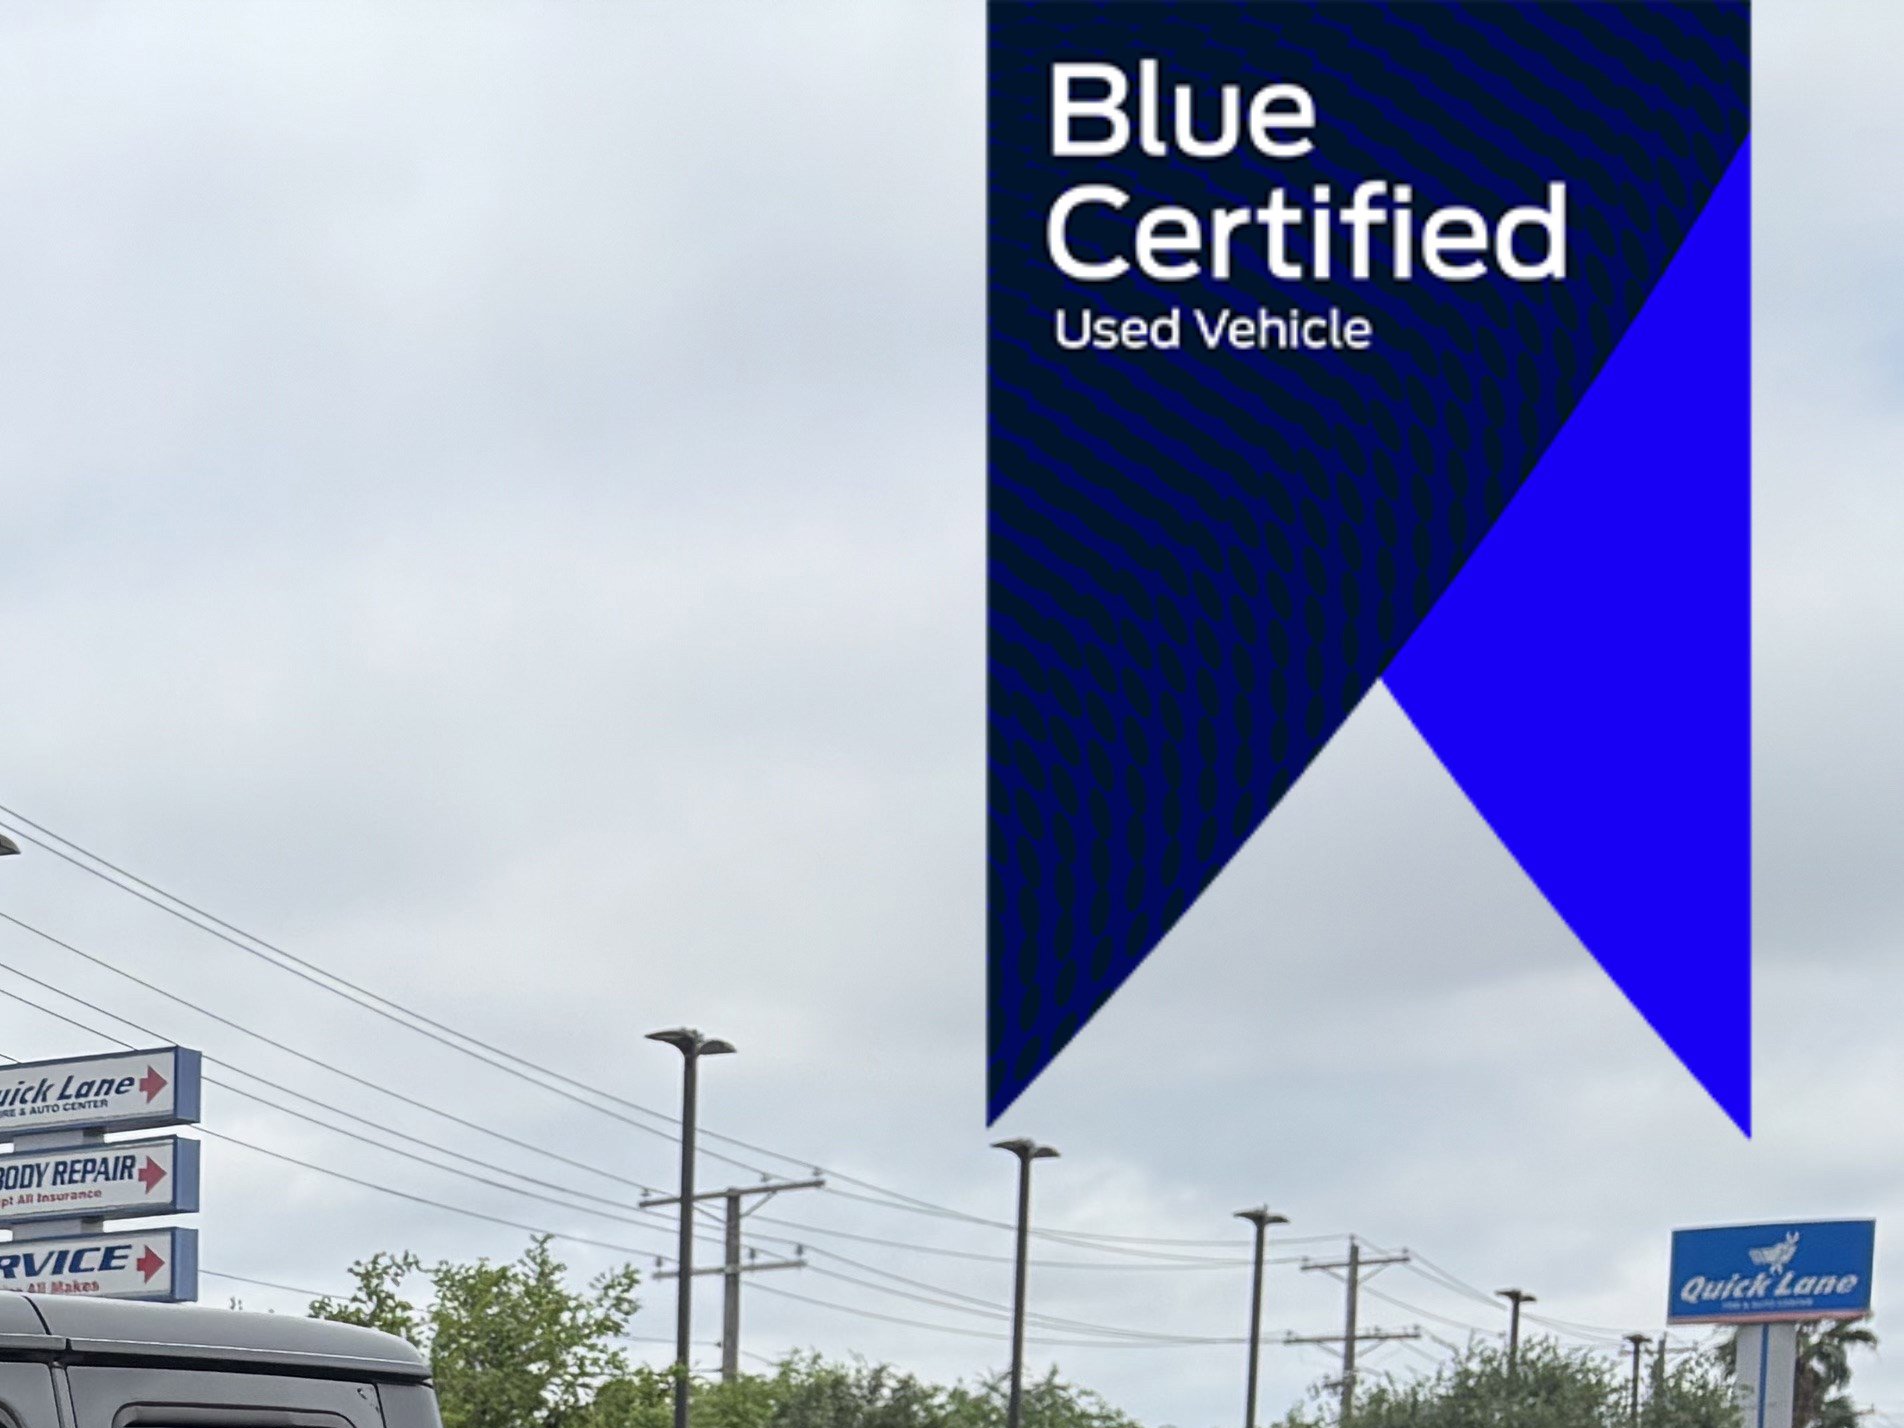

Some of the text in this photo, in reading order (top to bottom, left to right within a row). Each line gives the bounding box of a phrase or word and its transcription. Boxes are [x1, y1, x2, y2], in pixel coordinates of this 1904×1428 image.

[57, 1075, 135, 1102] Lane
[29, 1104, 61, 1115] AUTO
[63, 1099, 109, 1112] CENTER
[52, 1154, 137, 1187] REPAIR
[18, 1193, 34, 1205] All
[37, 1189, 102, 1204] Insurance
[51, 1279, 100, 1293] Makes
[1680, 1270, 1859, 1304] Quick Lane
